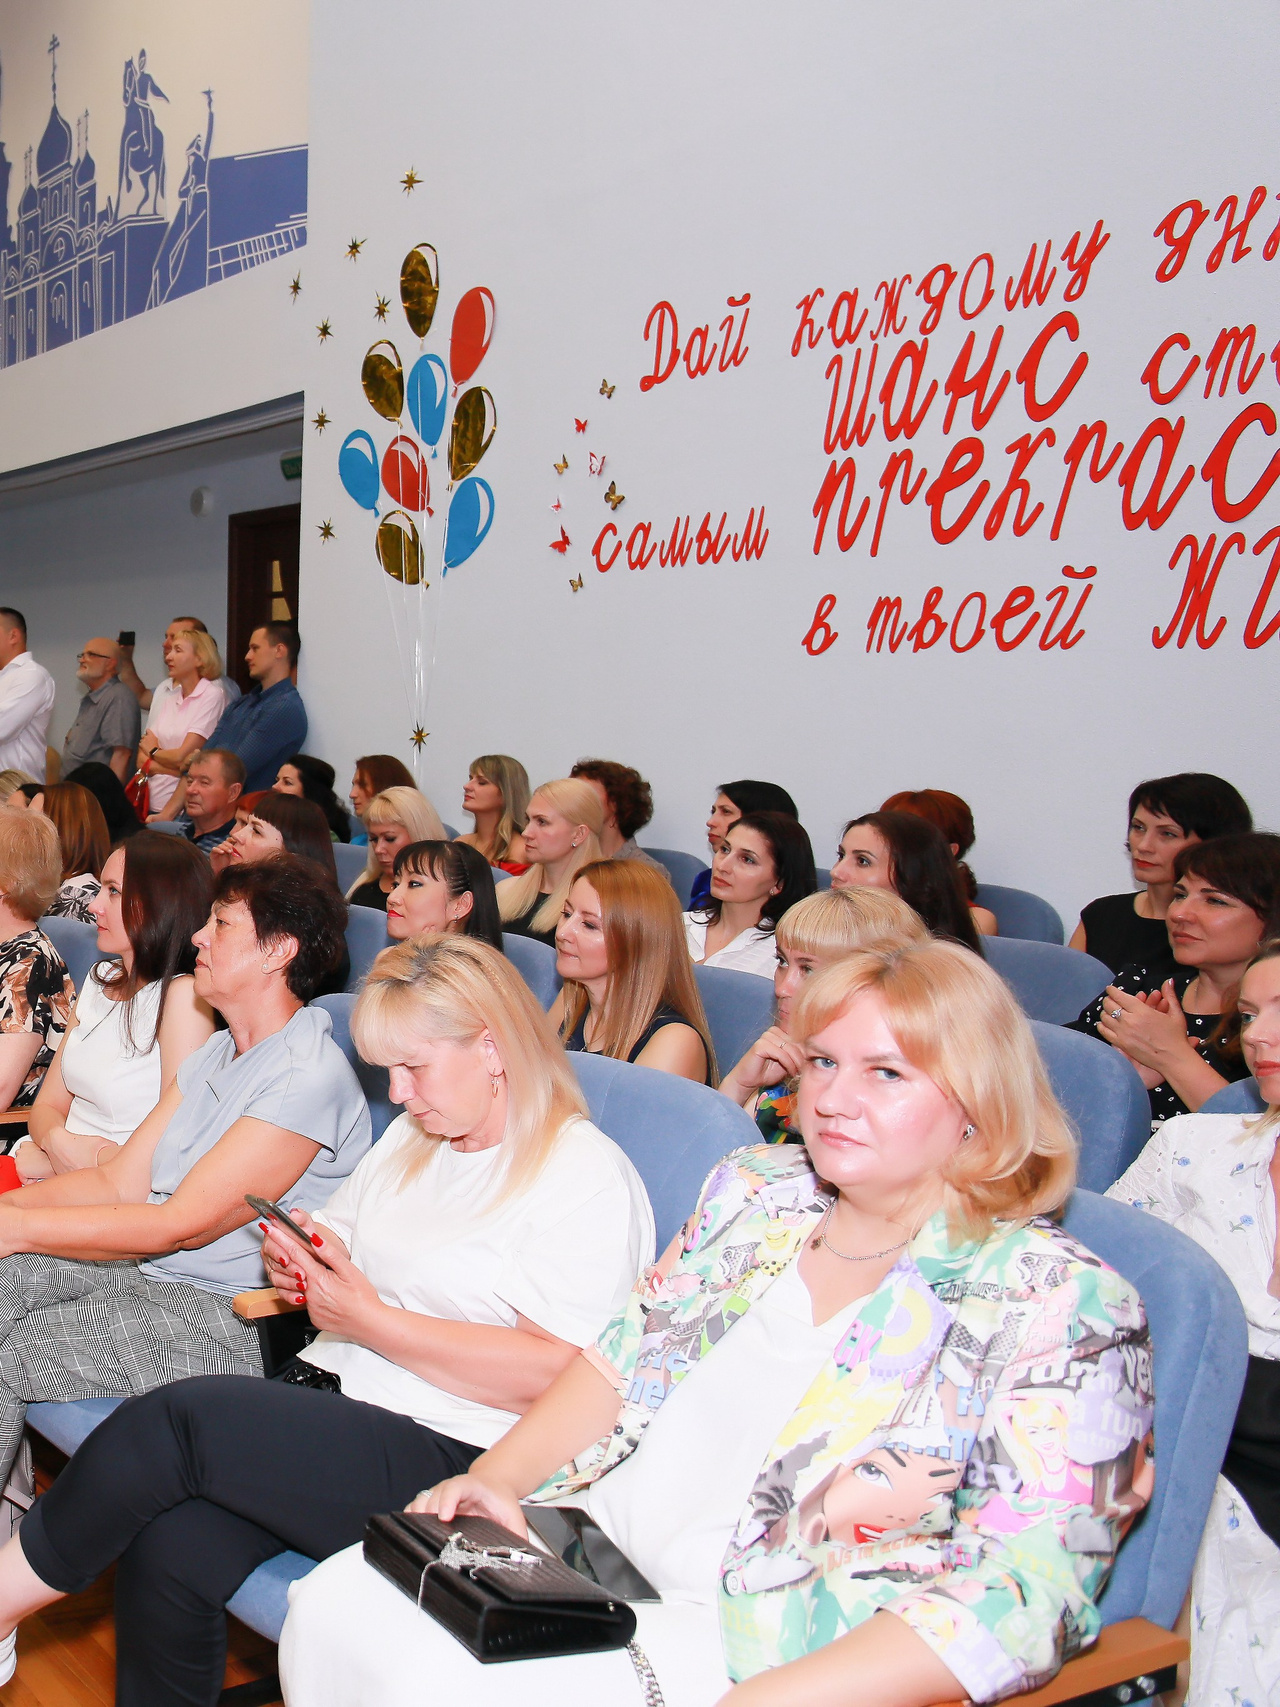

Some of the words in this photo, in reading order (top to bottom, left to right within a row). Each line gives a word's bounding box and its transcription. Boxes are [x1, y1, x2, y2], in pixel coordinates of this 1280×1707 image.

[639, 293, 751, 392] Дай
[791, 219, 1111, 358] каждому
[1140, 324, 1280, 405] ст
[591, 506, 770, 573] самым
[801, 593, 839, 656] в
[866, 565, 1098, 654] твоей
